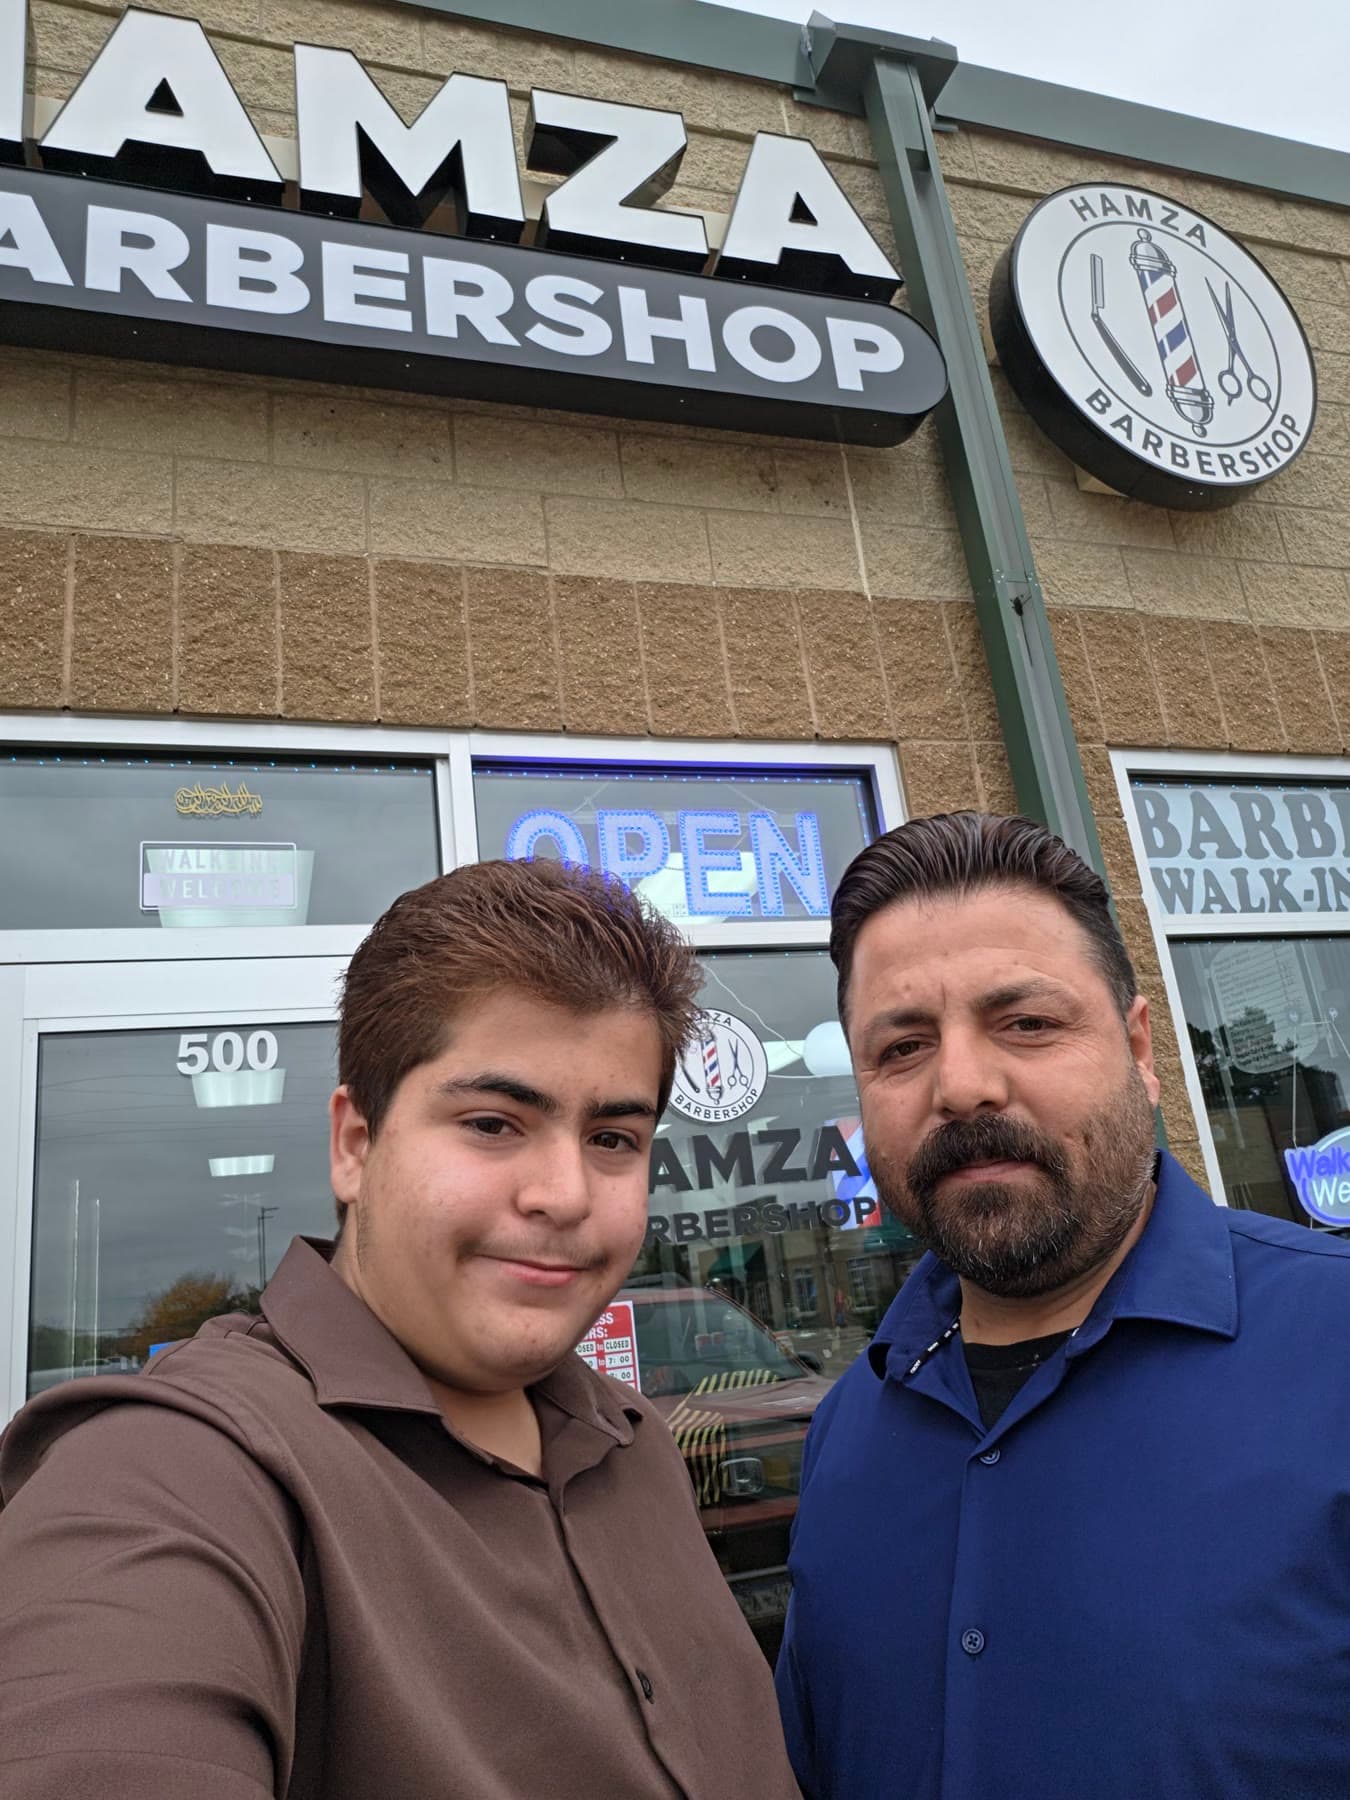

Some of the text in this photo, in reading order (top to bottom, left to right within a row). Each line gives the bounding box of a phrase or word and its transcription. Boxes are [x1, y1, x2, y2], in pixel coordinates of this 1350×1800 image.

[0, 0, 905, 281] AMZA
[1069, 193, 1207, 248] HAMZA
[1085, 388, 1301, 477] BARBERSHOP
[176, 1030, 278, 1075] 500
[674, 1089, 758, 1119] BARBERSHOP
[605, 1339, 630, 1350] CLOSED
